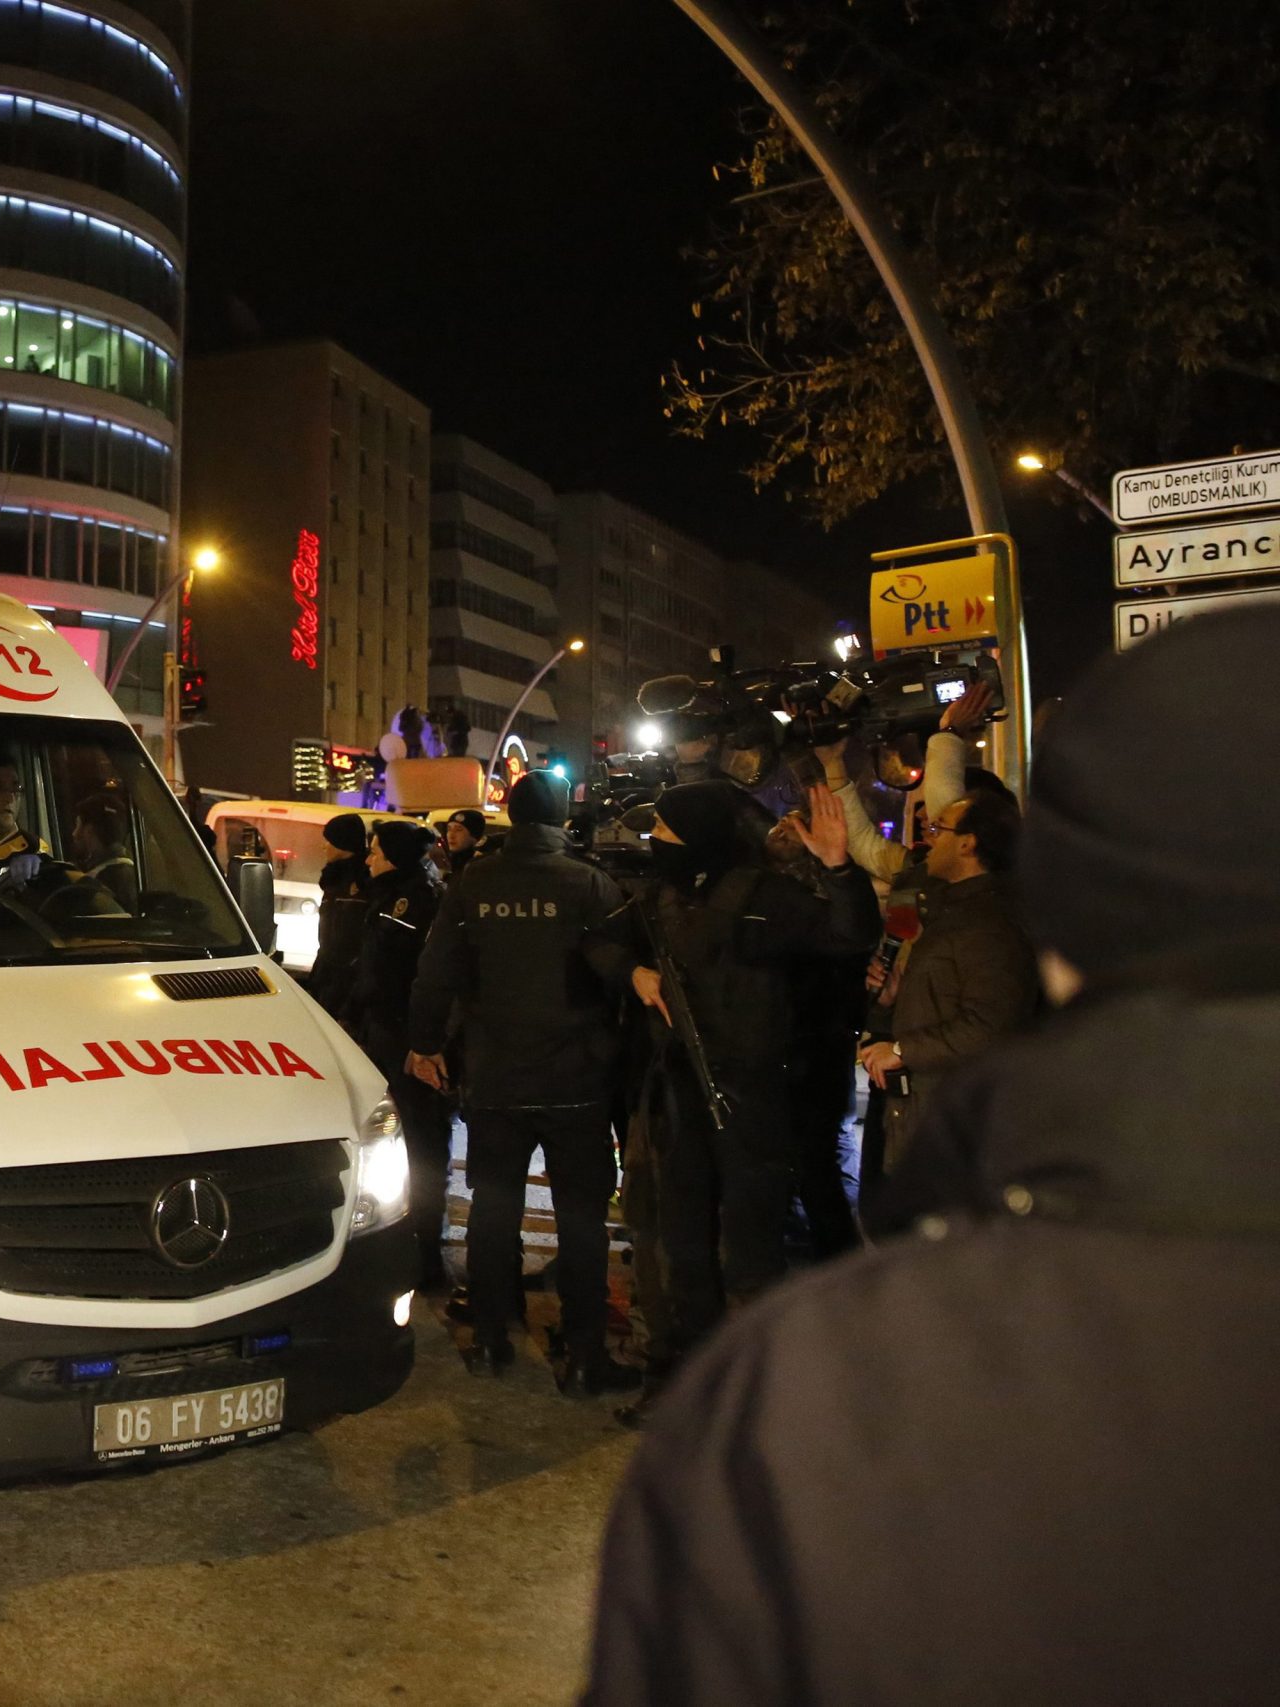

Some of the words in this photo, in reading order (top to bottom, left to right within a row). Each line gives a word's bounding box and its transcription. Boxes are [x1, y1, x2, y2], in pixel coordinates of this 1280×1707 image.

[1124, 477, 1160, 494] Kamu
[1165, 466, 1233, 488] Denetçiliği
[1148, 481, 1268, 514] (OMBUDSMANLIK)
[1129, 535, 1280, 573] Ayranc
[291, 590, 318, 670] Hotel
[904, 601, 952, 636] Ptt
[479, 898, 557, 918] POLİS
[117, 1405, 152, 1444] 06
[172, 1399, 205, 1437] FY
[219, 1384, 280, 1429] 5438
[160, 1439, 203, 1453] Mengerler
[209, 1433, 236, 1446] Ankara
